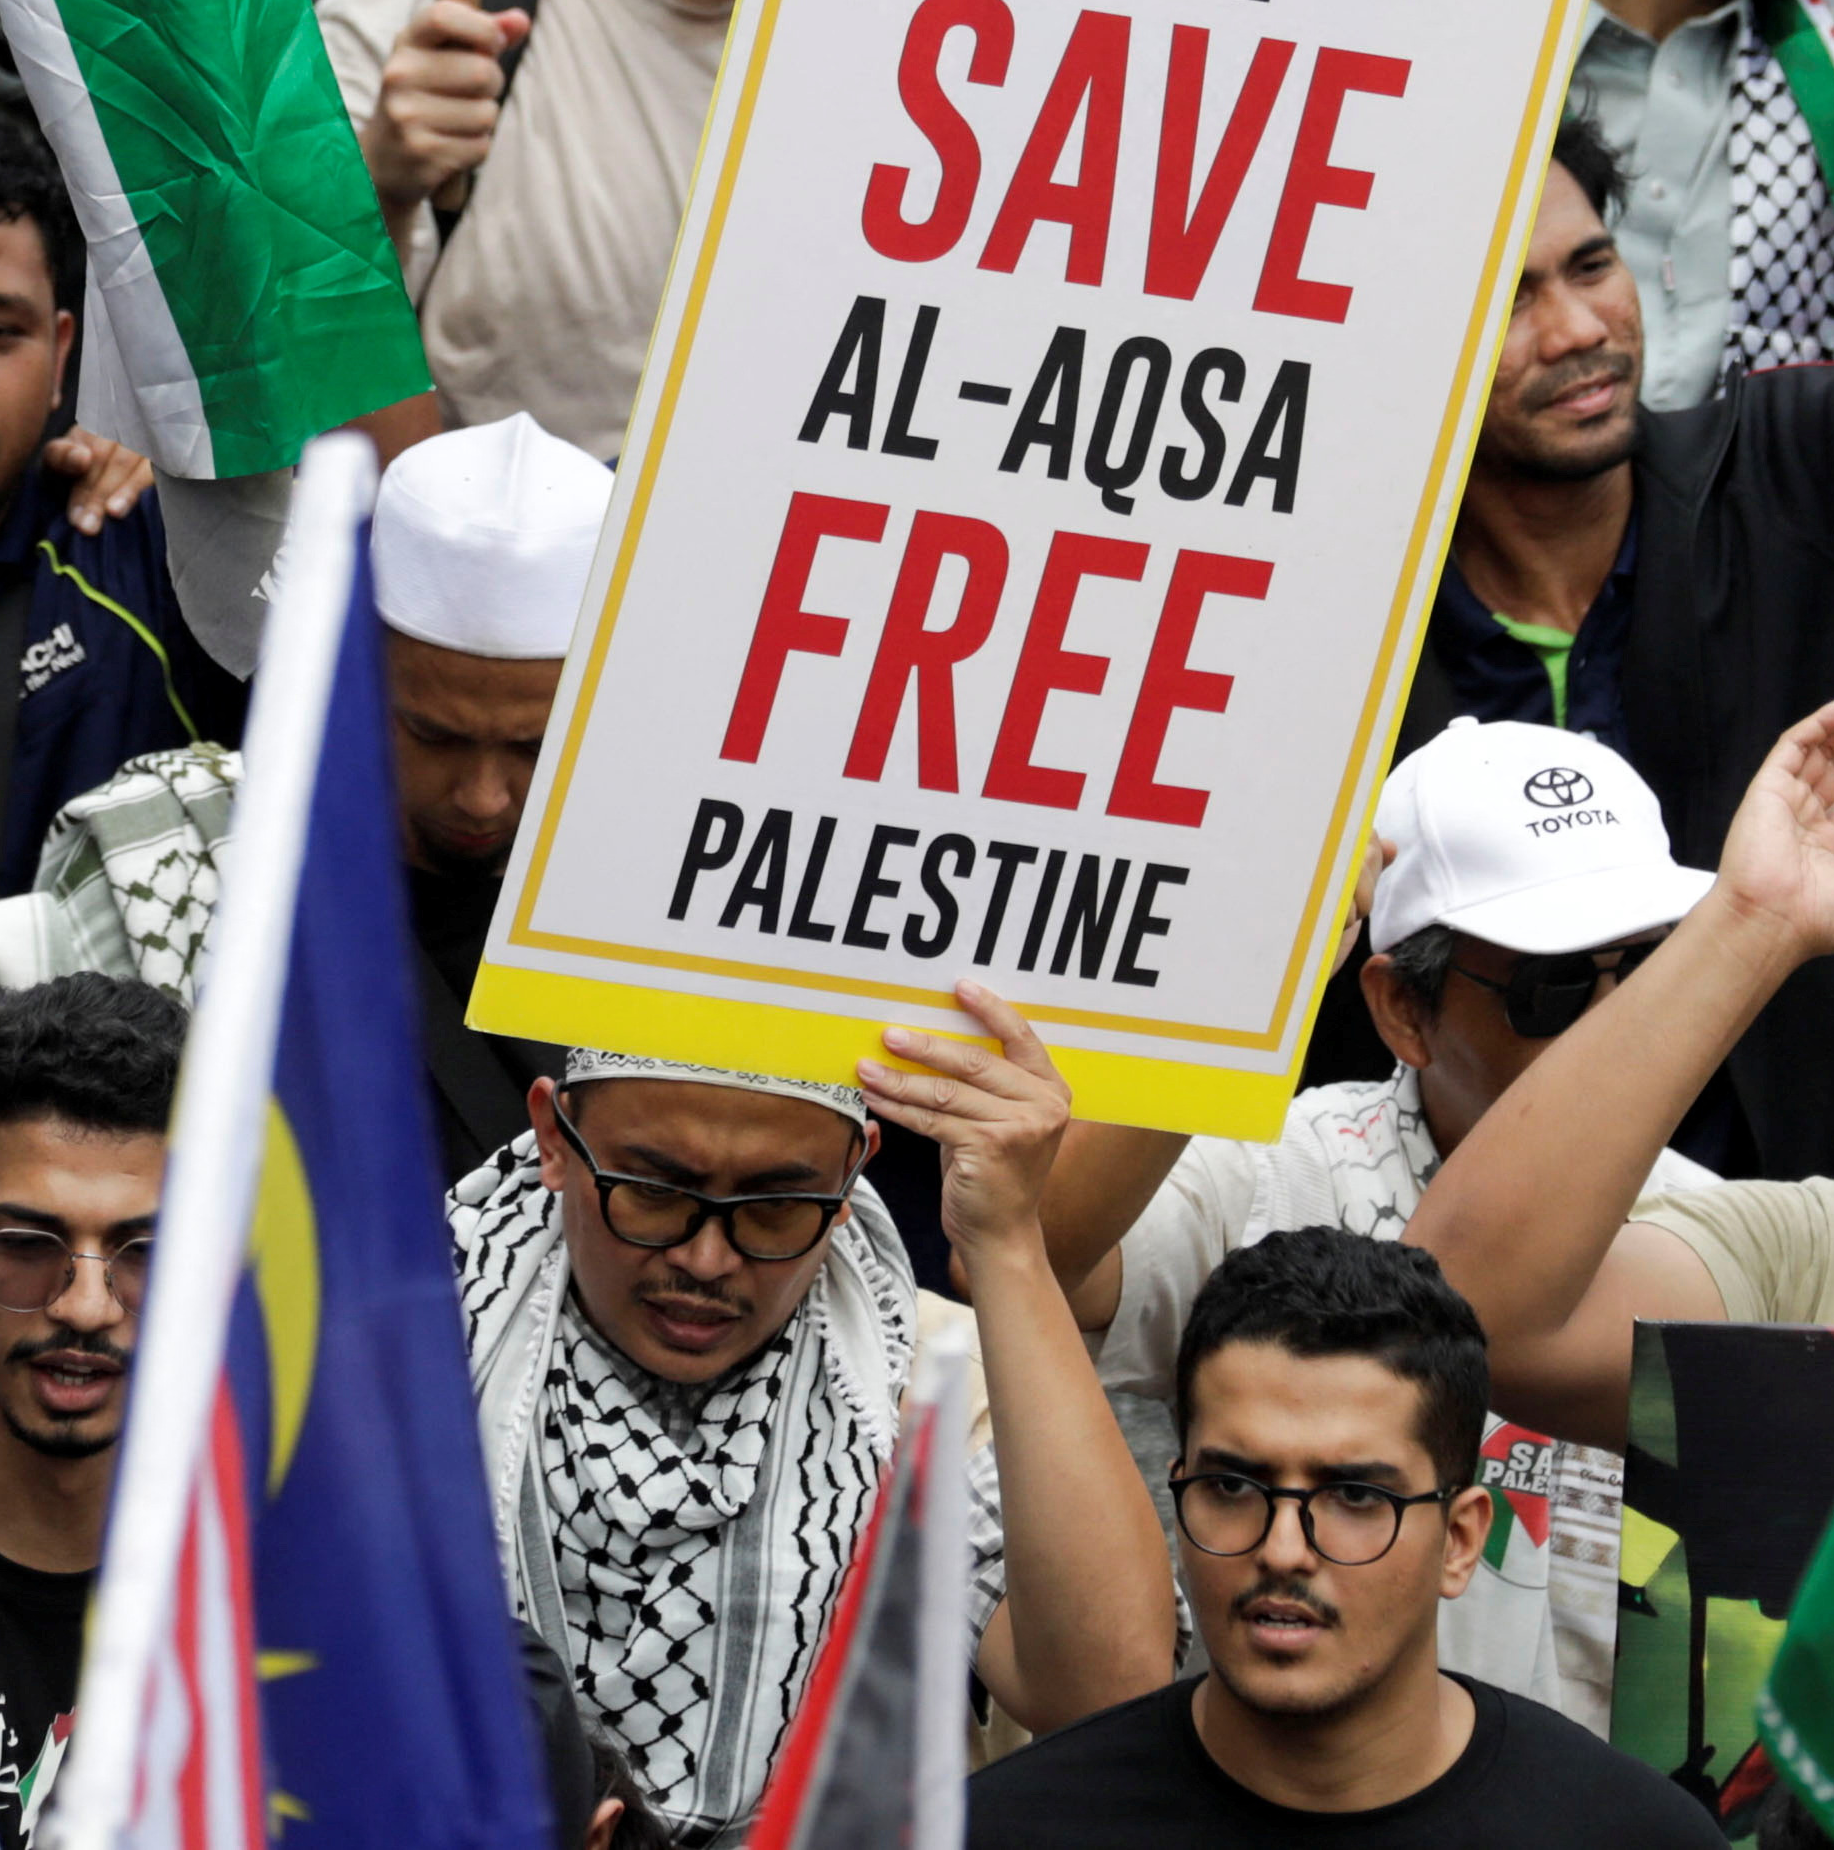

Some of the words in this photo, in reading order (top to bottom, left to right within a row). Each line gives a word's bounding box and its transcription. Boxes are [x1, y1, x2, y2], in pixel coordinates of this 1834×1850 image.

[796, 293, 1312, 516] AL-AQSA
[717, 490, 1276, 830] FREE
[666, 797, 1190, 989] PALESTINE
[1525, 808, 1621, 839] TOYOTA
